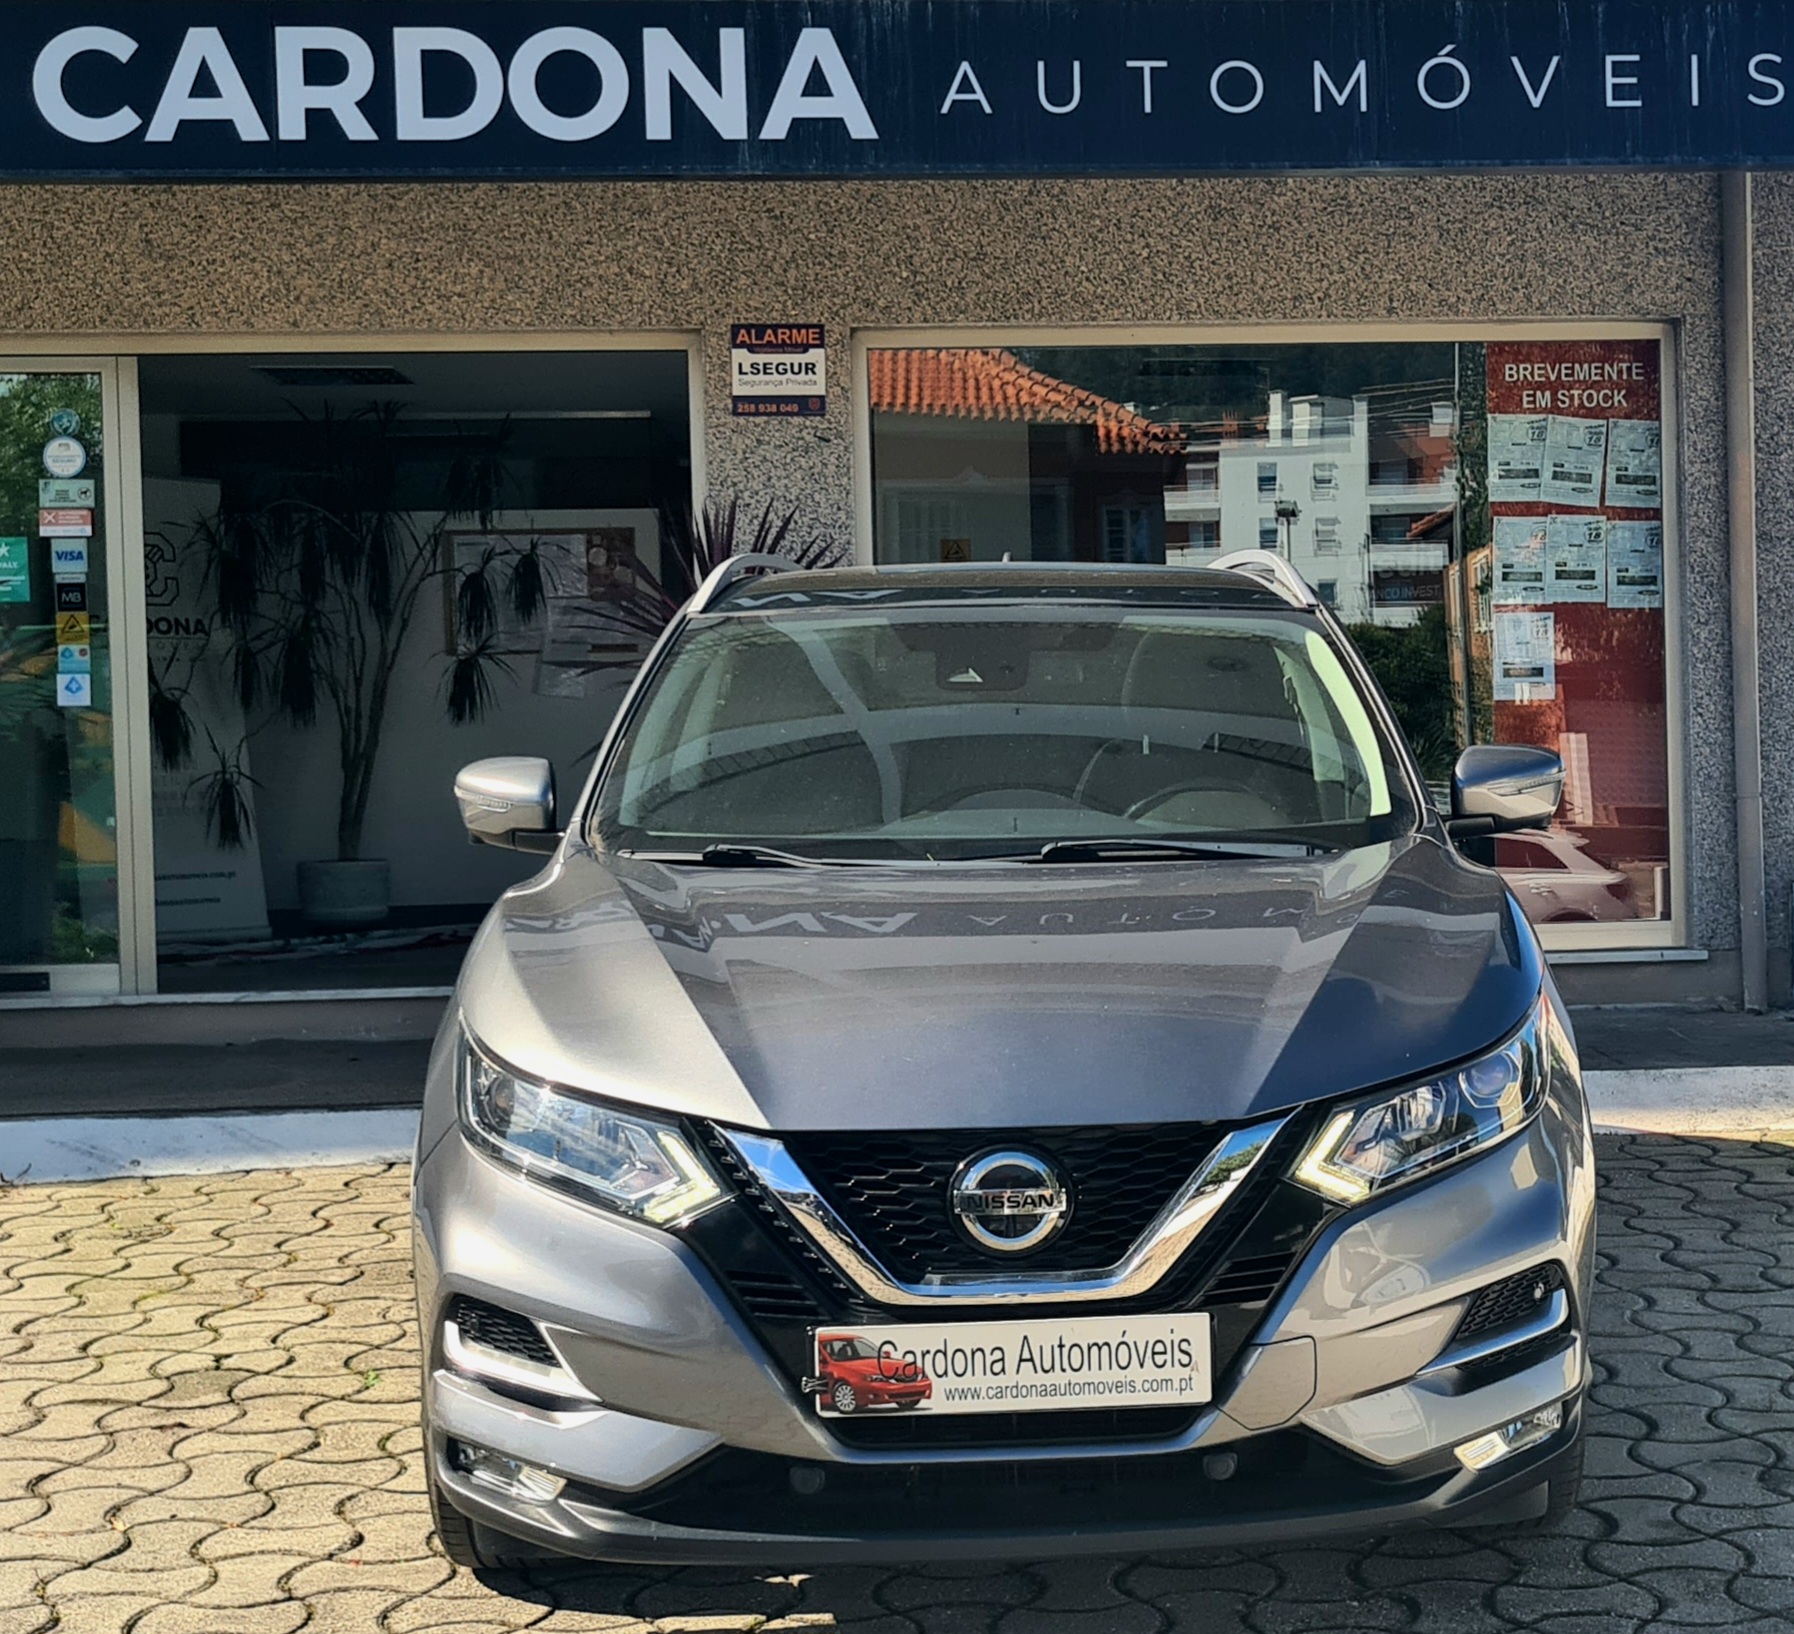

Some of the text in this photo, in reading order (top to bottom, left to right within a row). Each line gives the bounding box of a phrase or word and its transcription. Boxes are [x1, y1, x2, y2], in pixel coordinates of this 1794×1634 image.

[32, 25, 1787, 143] CARDONA AUTOMÓVEIS
[736, 328, 820, 344] ALARME
[738, 362, 817, 375] LSEGUR
[1504, 362, 1645, 382] BREVEMENTE
[738, 378, 817, 388] Segurança Privada
[1522, 389, 1627, 408] EM STOCK
[54, 550, 84, 562] VISA
[61, 591, 82, 604] MB
[967, 1193, 1055, 1209] NISSAN
[877, 1329, 1193, 1380] Cardona Automóveis
[944, 1374, 1193, 1401] www.cardonaautomoveis.com.pt
